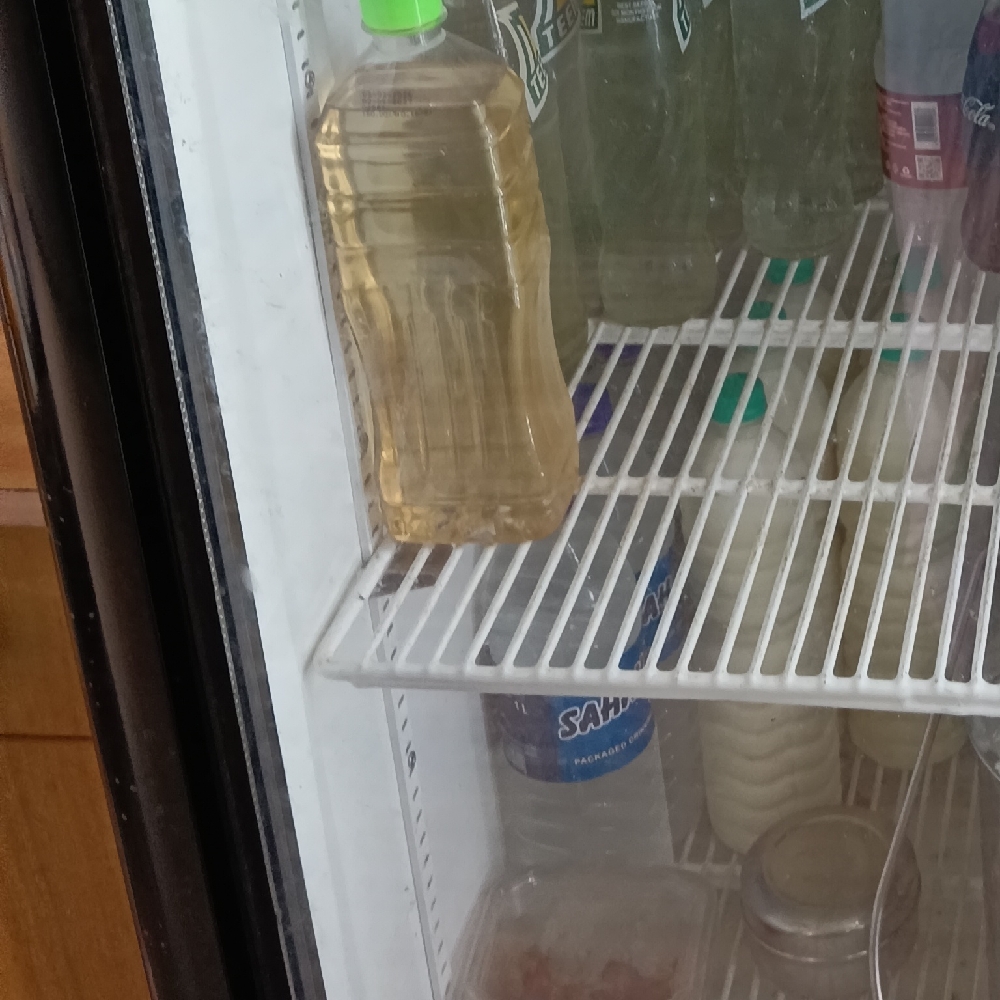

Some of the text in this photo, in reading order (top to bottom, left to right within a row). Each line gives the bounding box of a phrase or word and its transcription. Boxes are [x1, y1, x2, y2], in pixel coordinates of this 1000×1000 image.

[542, 4, 578, 48] TEE
[558, 696, 638, 741] SAH
[574, 741, 627, 766] PACKAGED
